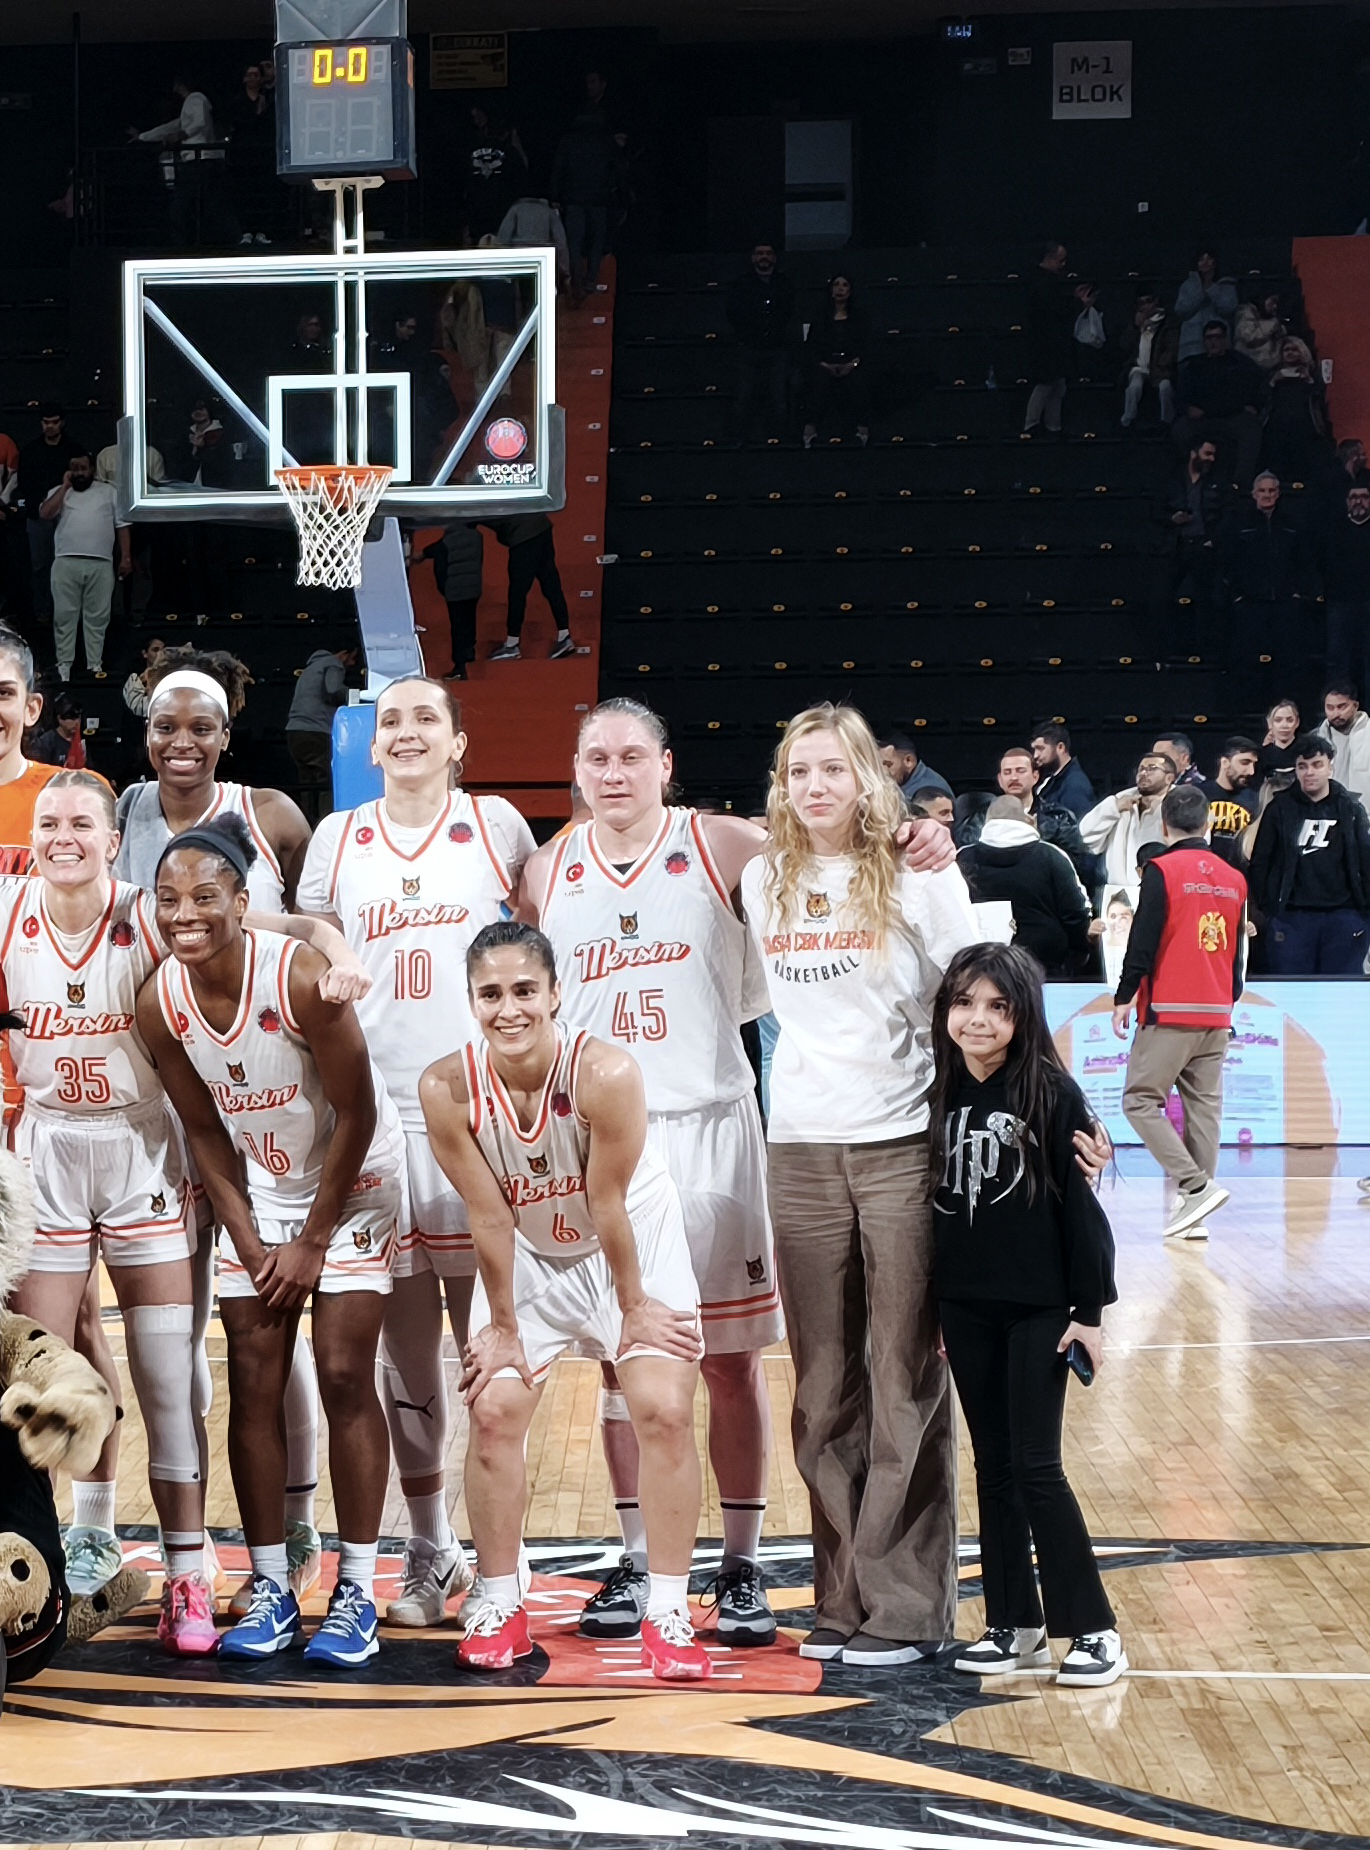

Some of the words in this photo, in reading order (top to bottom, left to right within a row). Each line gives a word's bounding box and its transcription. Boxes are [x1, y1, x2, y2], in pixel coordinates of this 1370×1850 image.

[313, 46, 367, 83] 0.0
[1070, 56, 1114, 74] M-1
[1058, 84, 1124, 103] BLOK
[478, 464, 534, 475] EUROCUP
[483, 474, 530, 484] WOMEN
[358, 897, 469, 942] Mersin
[394, 949, 432, 1000] 10
[574, 936, 692, 983] Mersin
[22, 1001, 134, 1039] Mersin
[612, 989, 668, 1043] 45
[54, 1056, 111, 1104] 35
[242, 1131, 291, 1176] 16
[553, 1213, 581, 1243] 6
